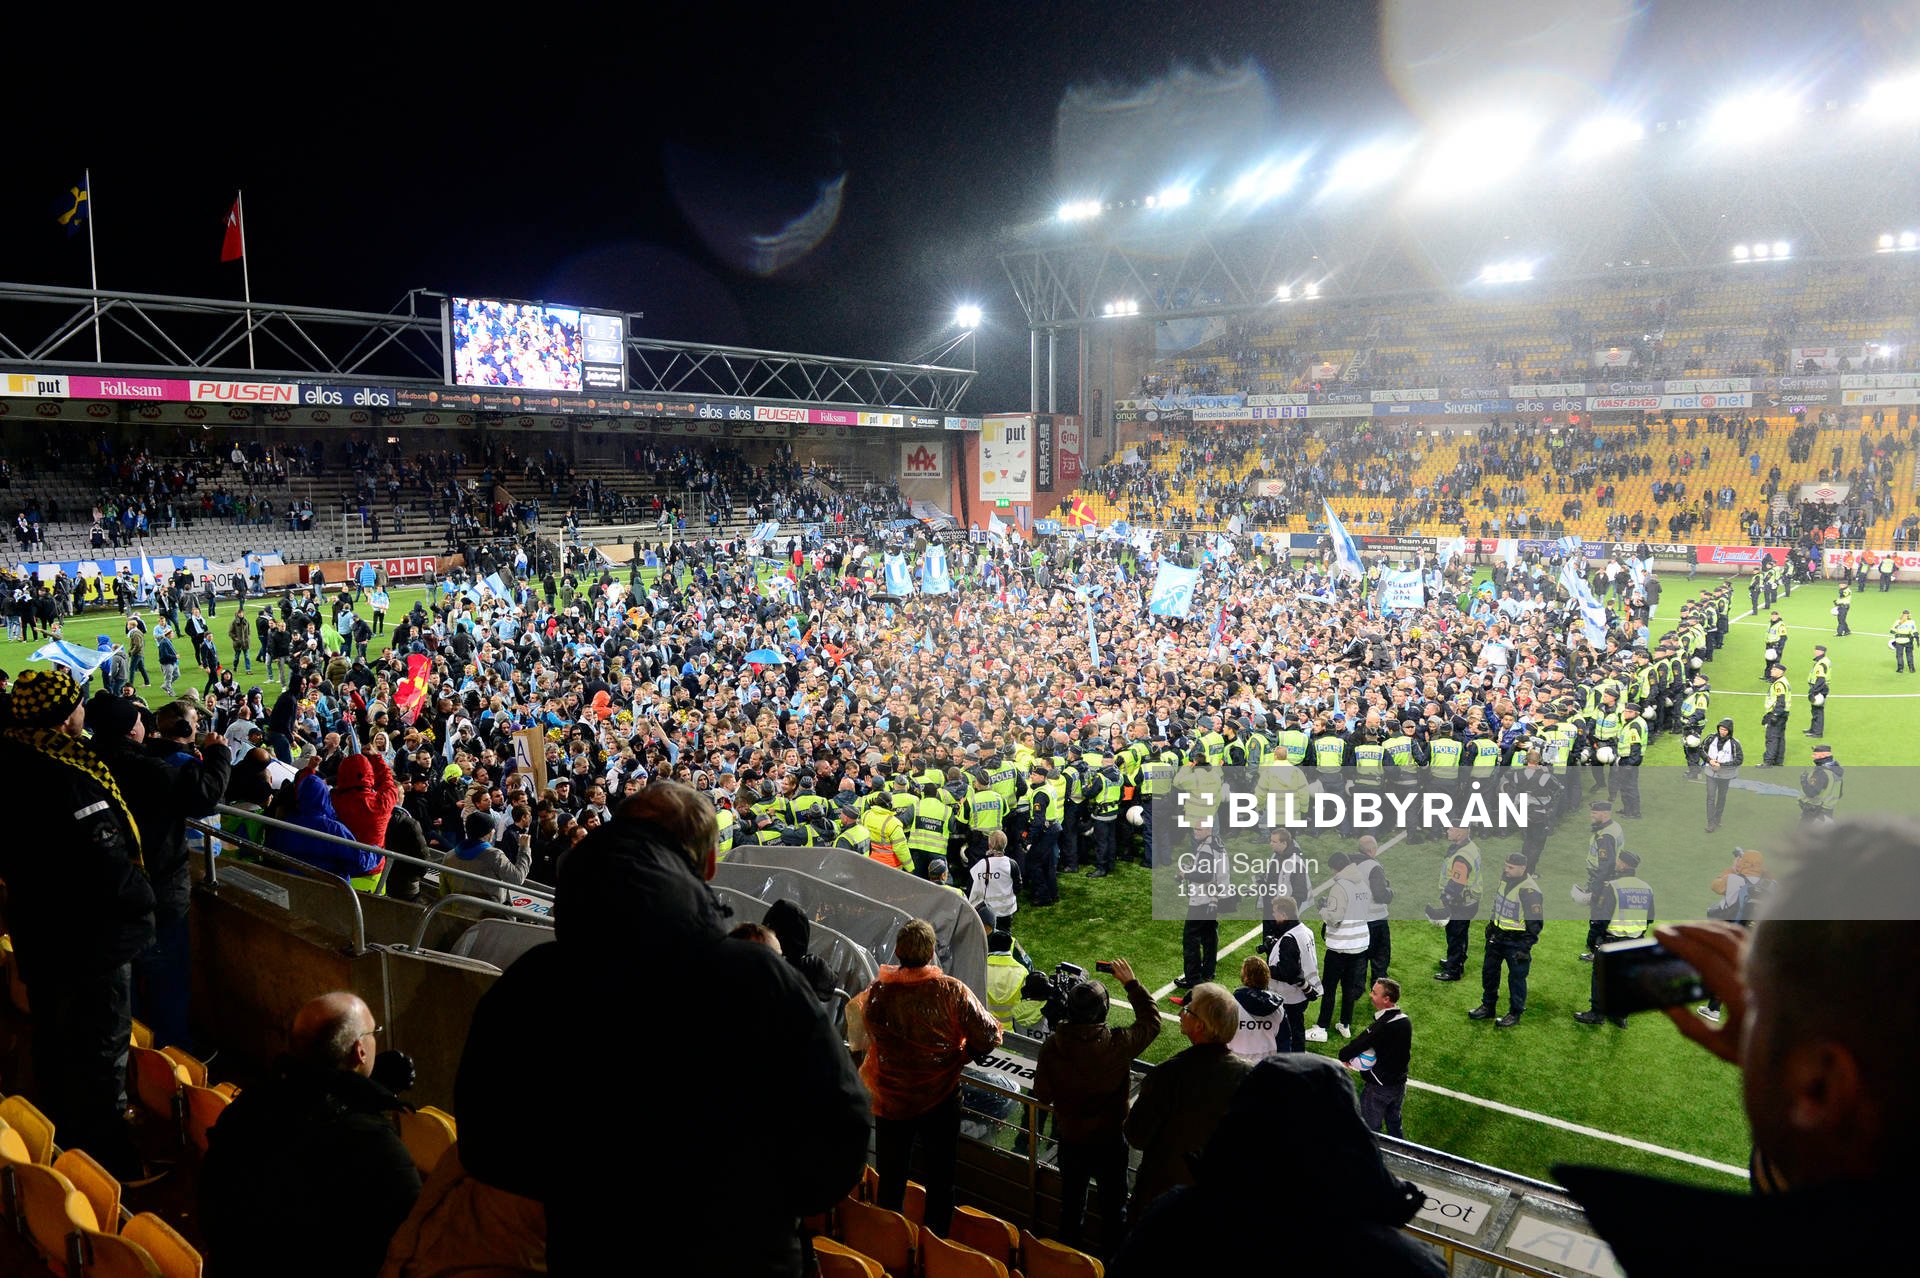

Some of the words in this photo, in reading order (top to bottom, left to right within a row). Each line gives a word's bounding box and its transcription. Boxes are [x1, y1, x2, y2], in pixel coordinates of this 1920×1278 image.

[100, 381, 162, 397] Folksam
[197, 383, 292, 401] PULSEN
[305, 386, 343, 405] ellos
[353, 387, 390, 406] ellos
[699, 403, 723, 419] ellos
[1515, 400, 1545, 412] ellos
[1552, 399, 1582, 411] ellos
[728, 405, 751, 420] ellos
[757, 408, 806, 421] PULSEN
[820, 412, 846, 423] Folksam
[1115, 412, 1137, 421] onyx
[1194, 409, 1249, 419] Handelsbanken
[907, 445, 937, 471] MAX
[1398, 537, 1420, 545] Team
[1665, 544, 1688, 553] AB
[517, 738, 531, 768] A
[1358, 751, 1380, 760] POLIS
[1434, 746, 1458, 755] POLIS
[991, 770, 1014, 783] POLIS
[974, 801, 1000, 812] POLIS
[977, 871, 1001, 881] FOTO
[1626, 895, 1649, 904] POLIS
[1239, 1020, 1273, 1031] FOTO
[1026, 1028, 1050, 1040] FOT
[1420, 1197, 1476, 1223] cot
[1522, 1230, 1605, 1272] AT
